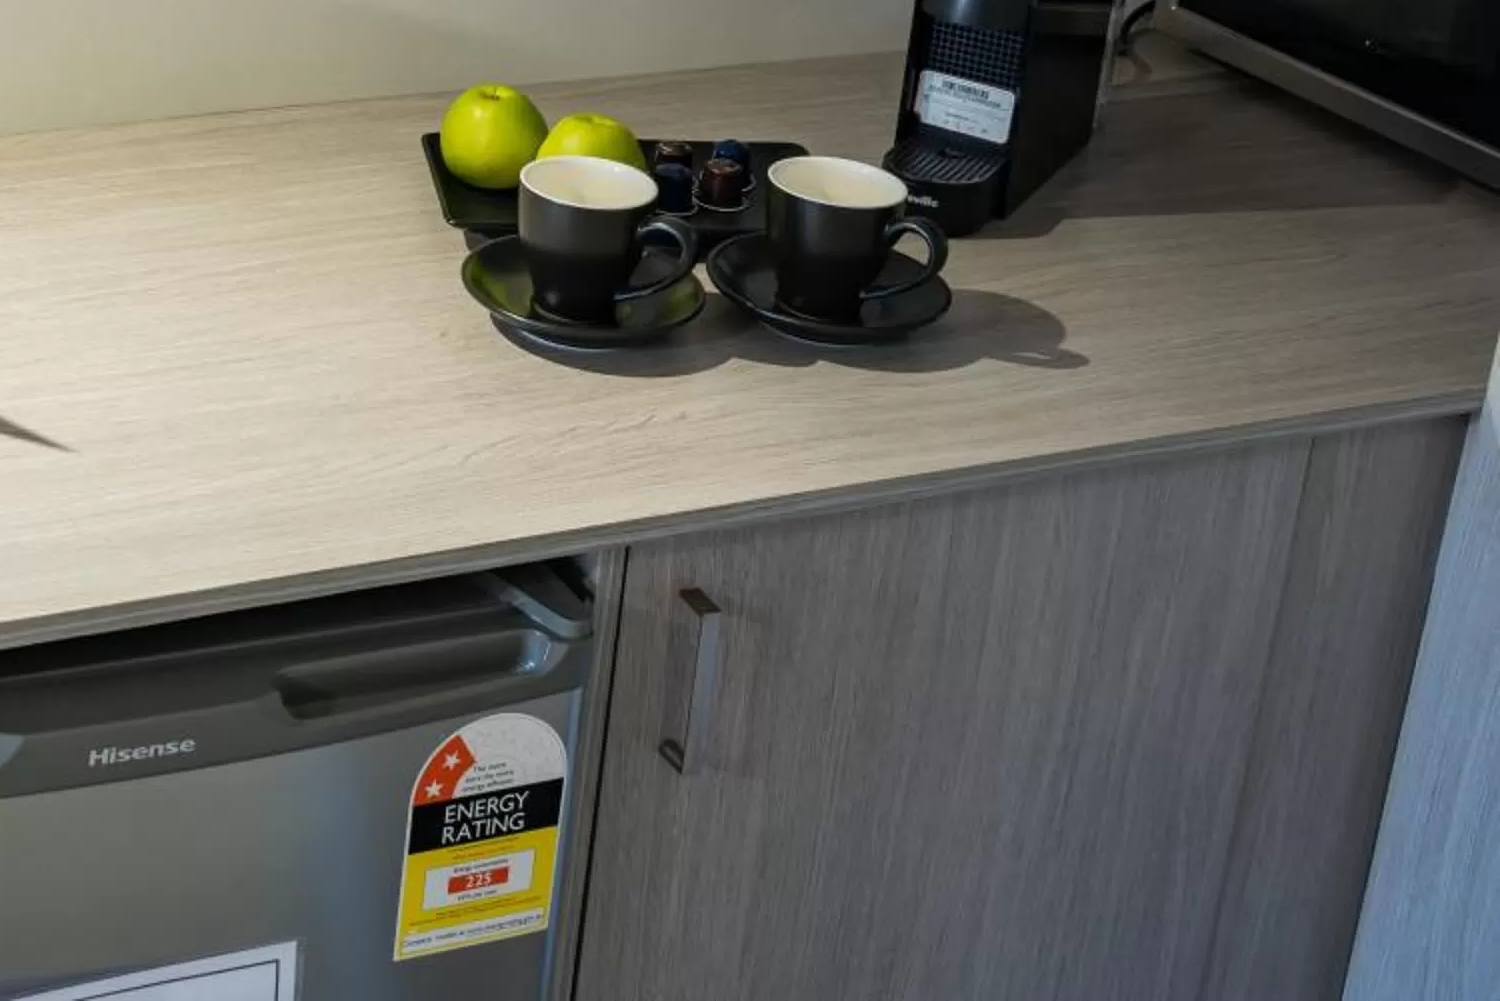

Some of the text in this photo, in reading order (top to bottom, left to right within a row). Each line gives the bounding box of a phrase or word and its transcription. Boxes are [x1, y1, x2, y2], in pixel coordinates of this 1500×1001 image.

[87, 738, 197, 768] Hisense
[444, 790, 530, 825] ENERGY
[441, 812, 526, 845] RATING
[465, 872, 493, 889] 225
